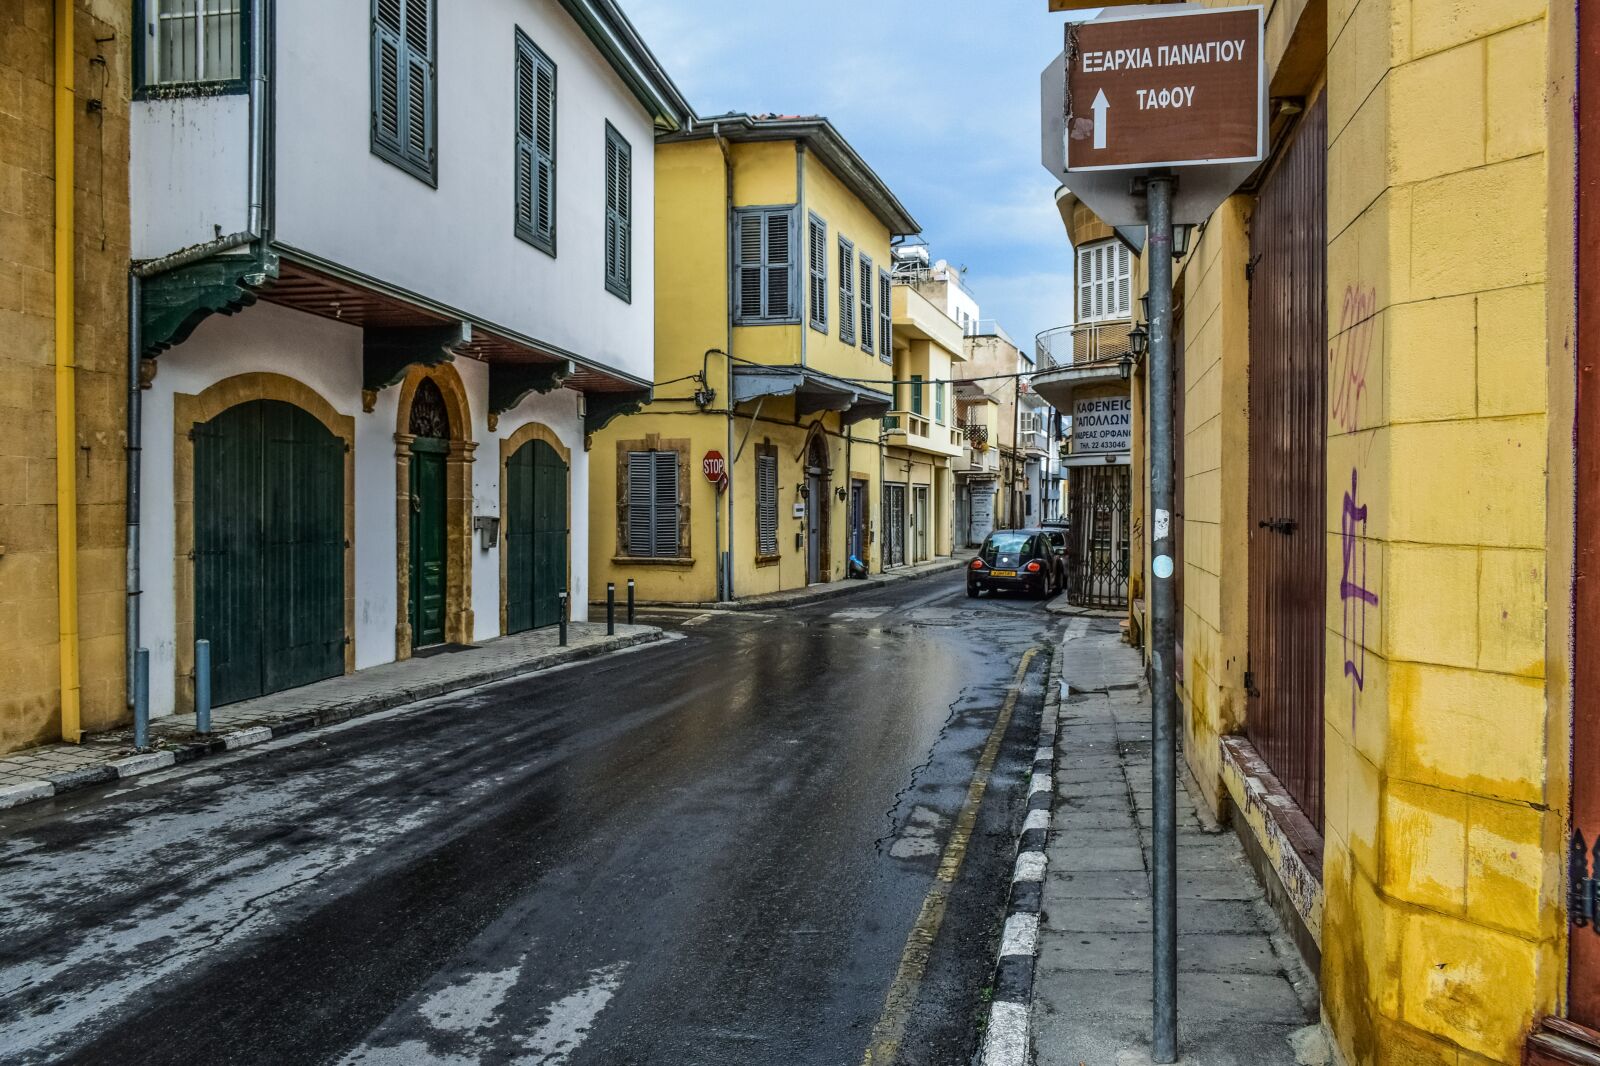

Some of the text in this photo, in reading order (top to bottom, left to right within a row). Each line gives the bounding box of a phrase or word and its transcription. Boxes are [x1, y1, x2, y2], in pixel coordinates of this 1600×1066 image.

[1082, 39, 1246, 73] ΕΞΑΡΧΙΑ ΠΑΝΑΓΙΟΥ
[1136, 86, 1195, 111] ΤΑΦΟΥ
[1091, 441, 1099, 449] 22
[704, 459, 724, 474] STOP
